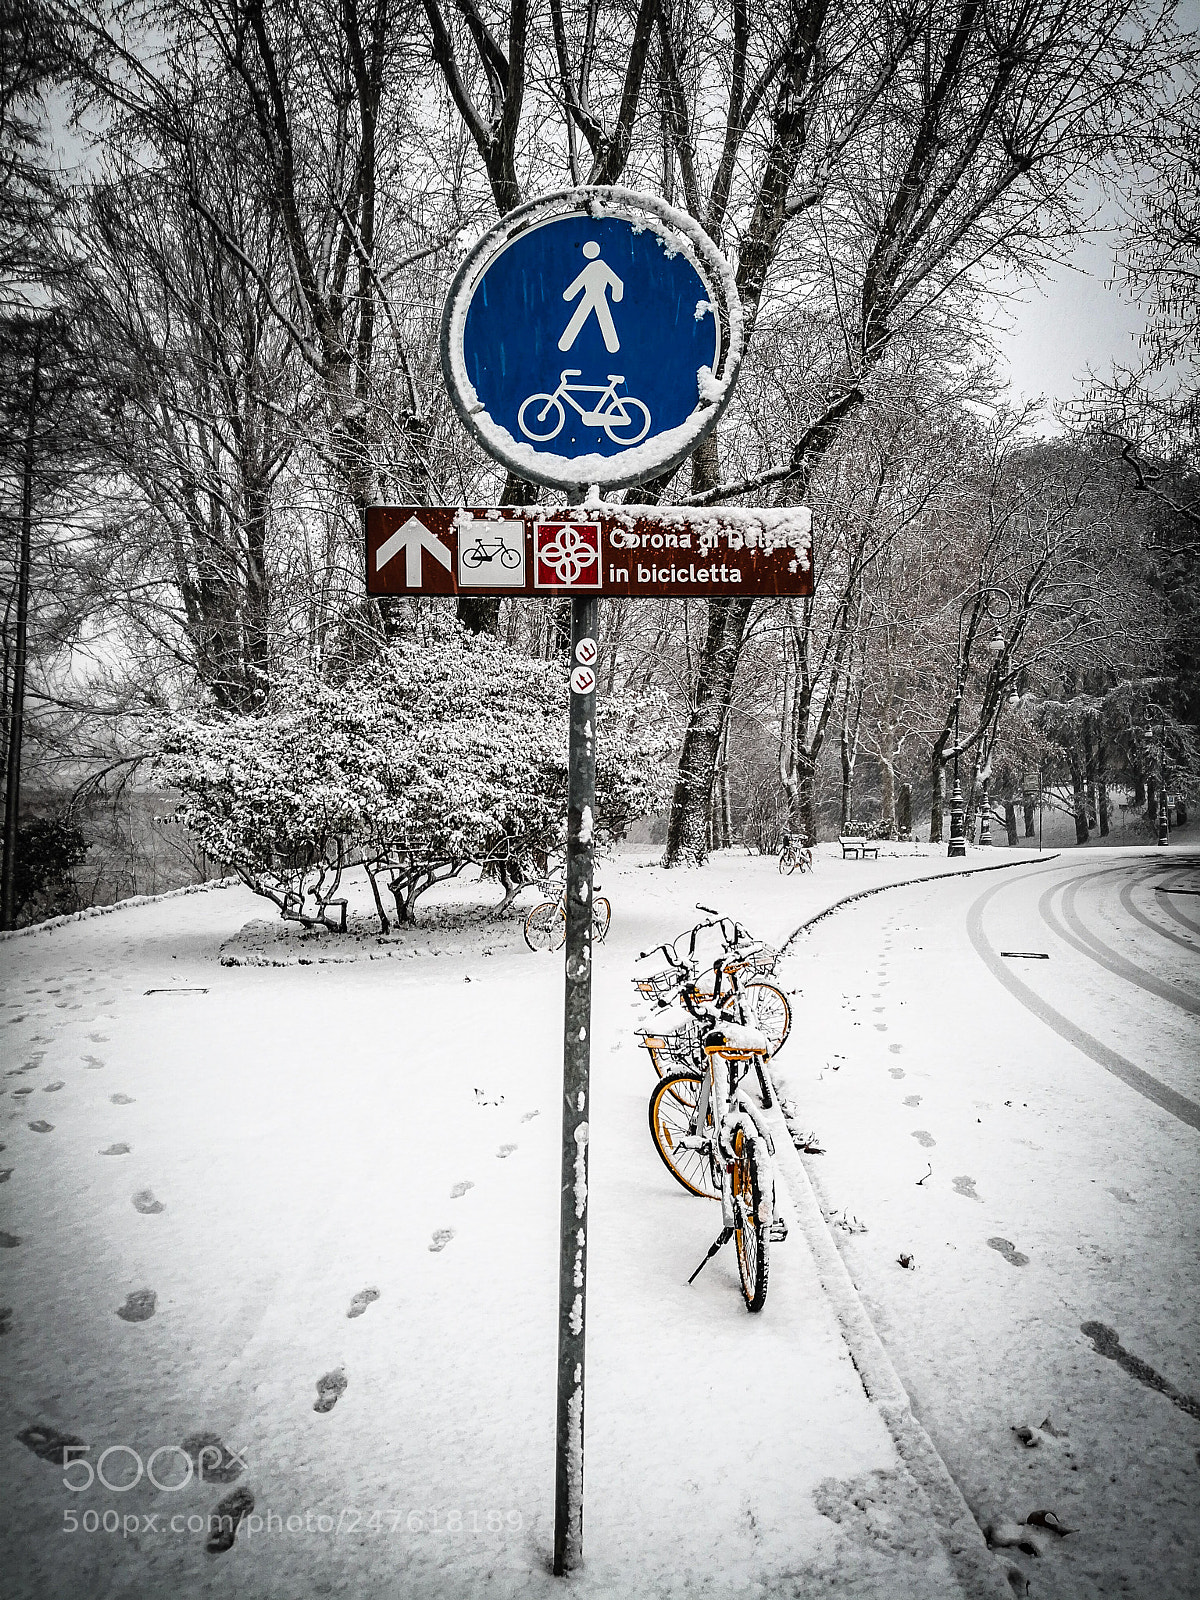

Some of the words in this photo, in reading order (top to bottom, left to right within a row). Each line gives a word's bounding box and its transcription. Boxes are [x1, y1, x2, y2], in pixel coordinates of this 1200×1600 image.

[609, 528, 692, 548] Corona
[609, 563, 629, 583] in
[637, 563, 742, 583] bicicletta
